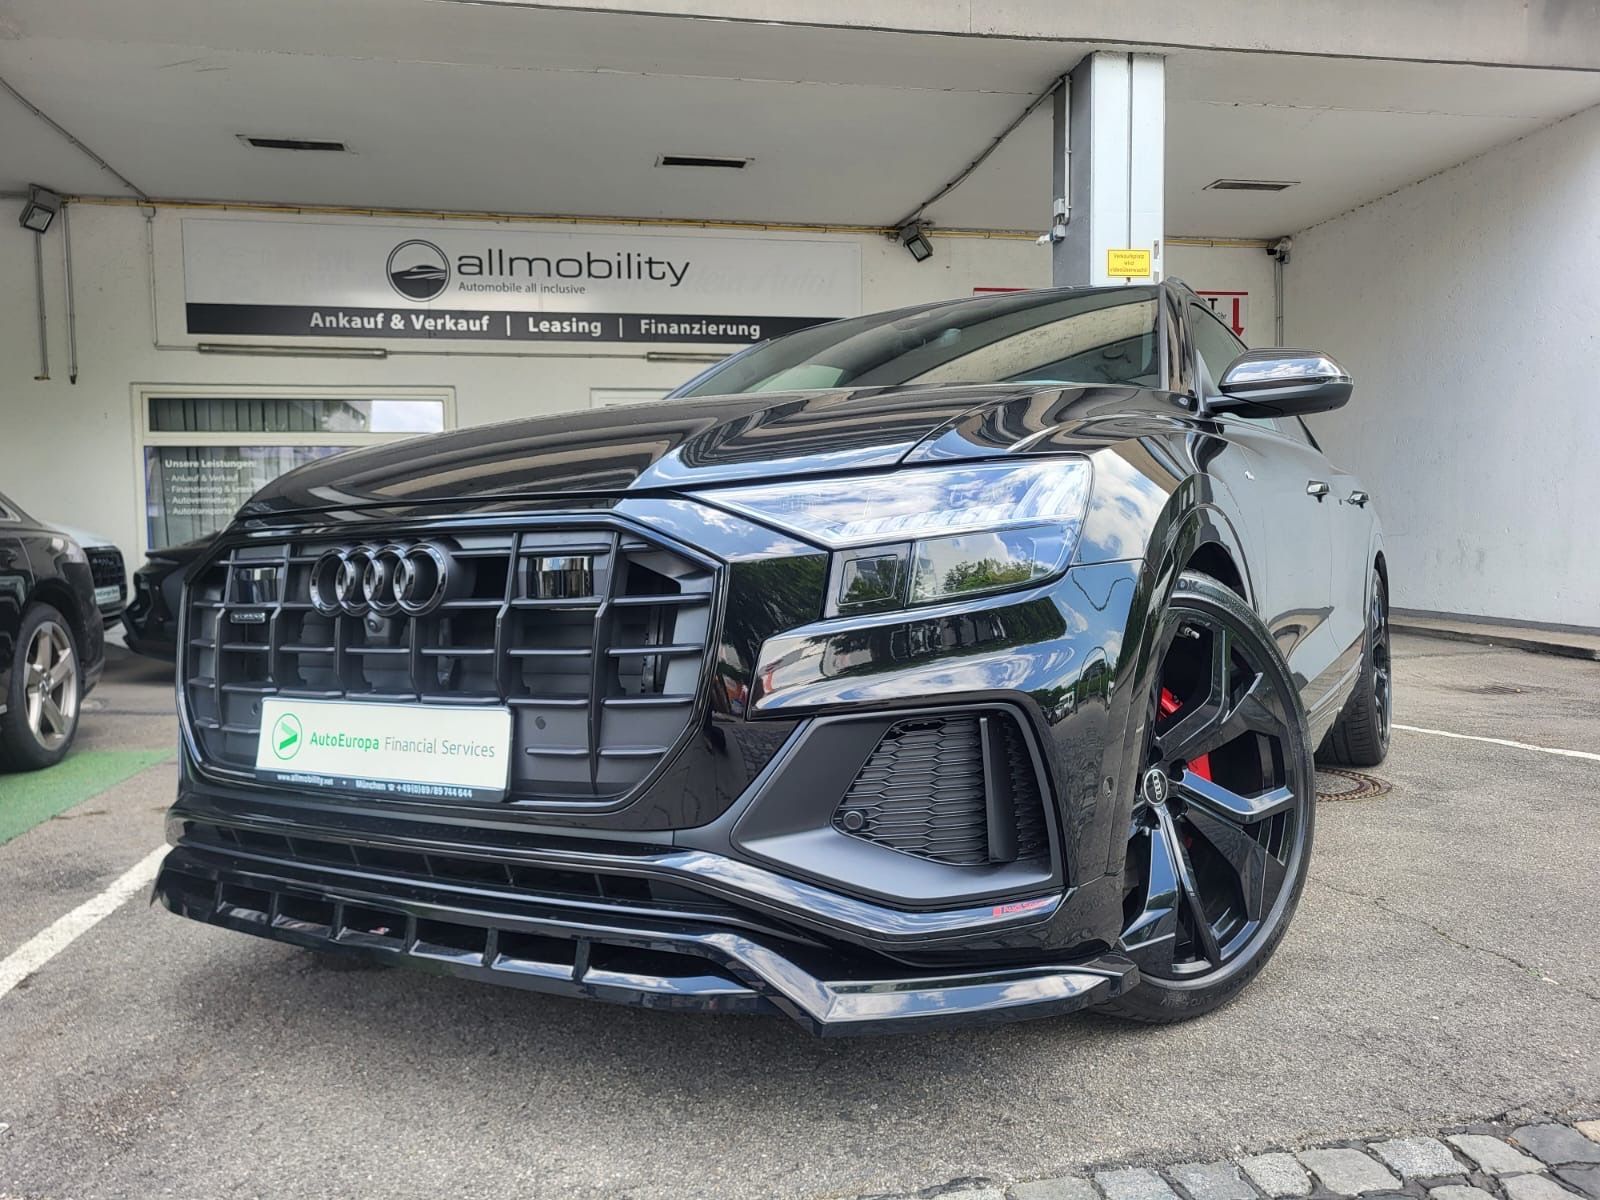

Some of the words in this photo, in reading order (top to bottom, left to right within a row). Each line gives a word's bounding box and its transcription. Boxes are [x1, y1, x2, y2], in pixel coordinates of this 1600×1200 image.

[457, 248, 690, 287] allmobility
[458, 281, 523, 294] Automobile
[525, 283, 537, 294] all
[540, 283, 586, 295] inclusive
[310, 312, 385, 329] Ankauf
[390, 314, 405, 330] &
[411, 314, 490, 332] Verkauf
[528, 317, 602, 336] Leasing
[640, 319, 761, 339] Finanzierung
[165, 459, 199, 468] Unsere
[310, 732, 380, 752] AutoEuropa
[384, 736, 437, 754] Financial
[441, 739, 495, 758] Services
[355, 779, 387, 790] München
